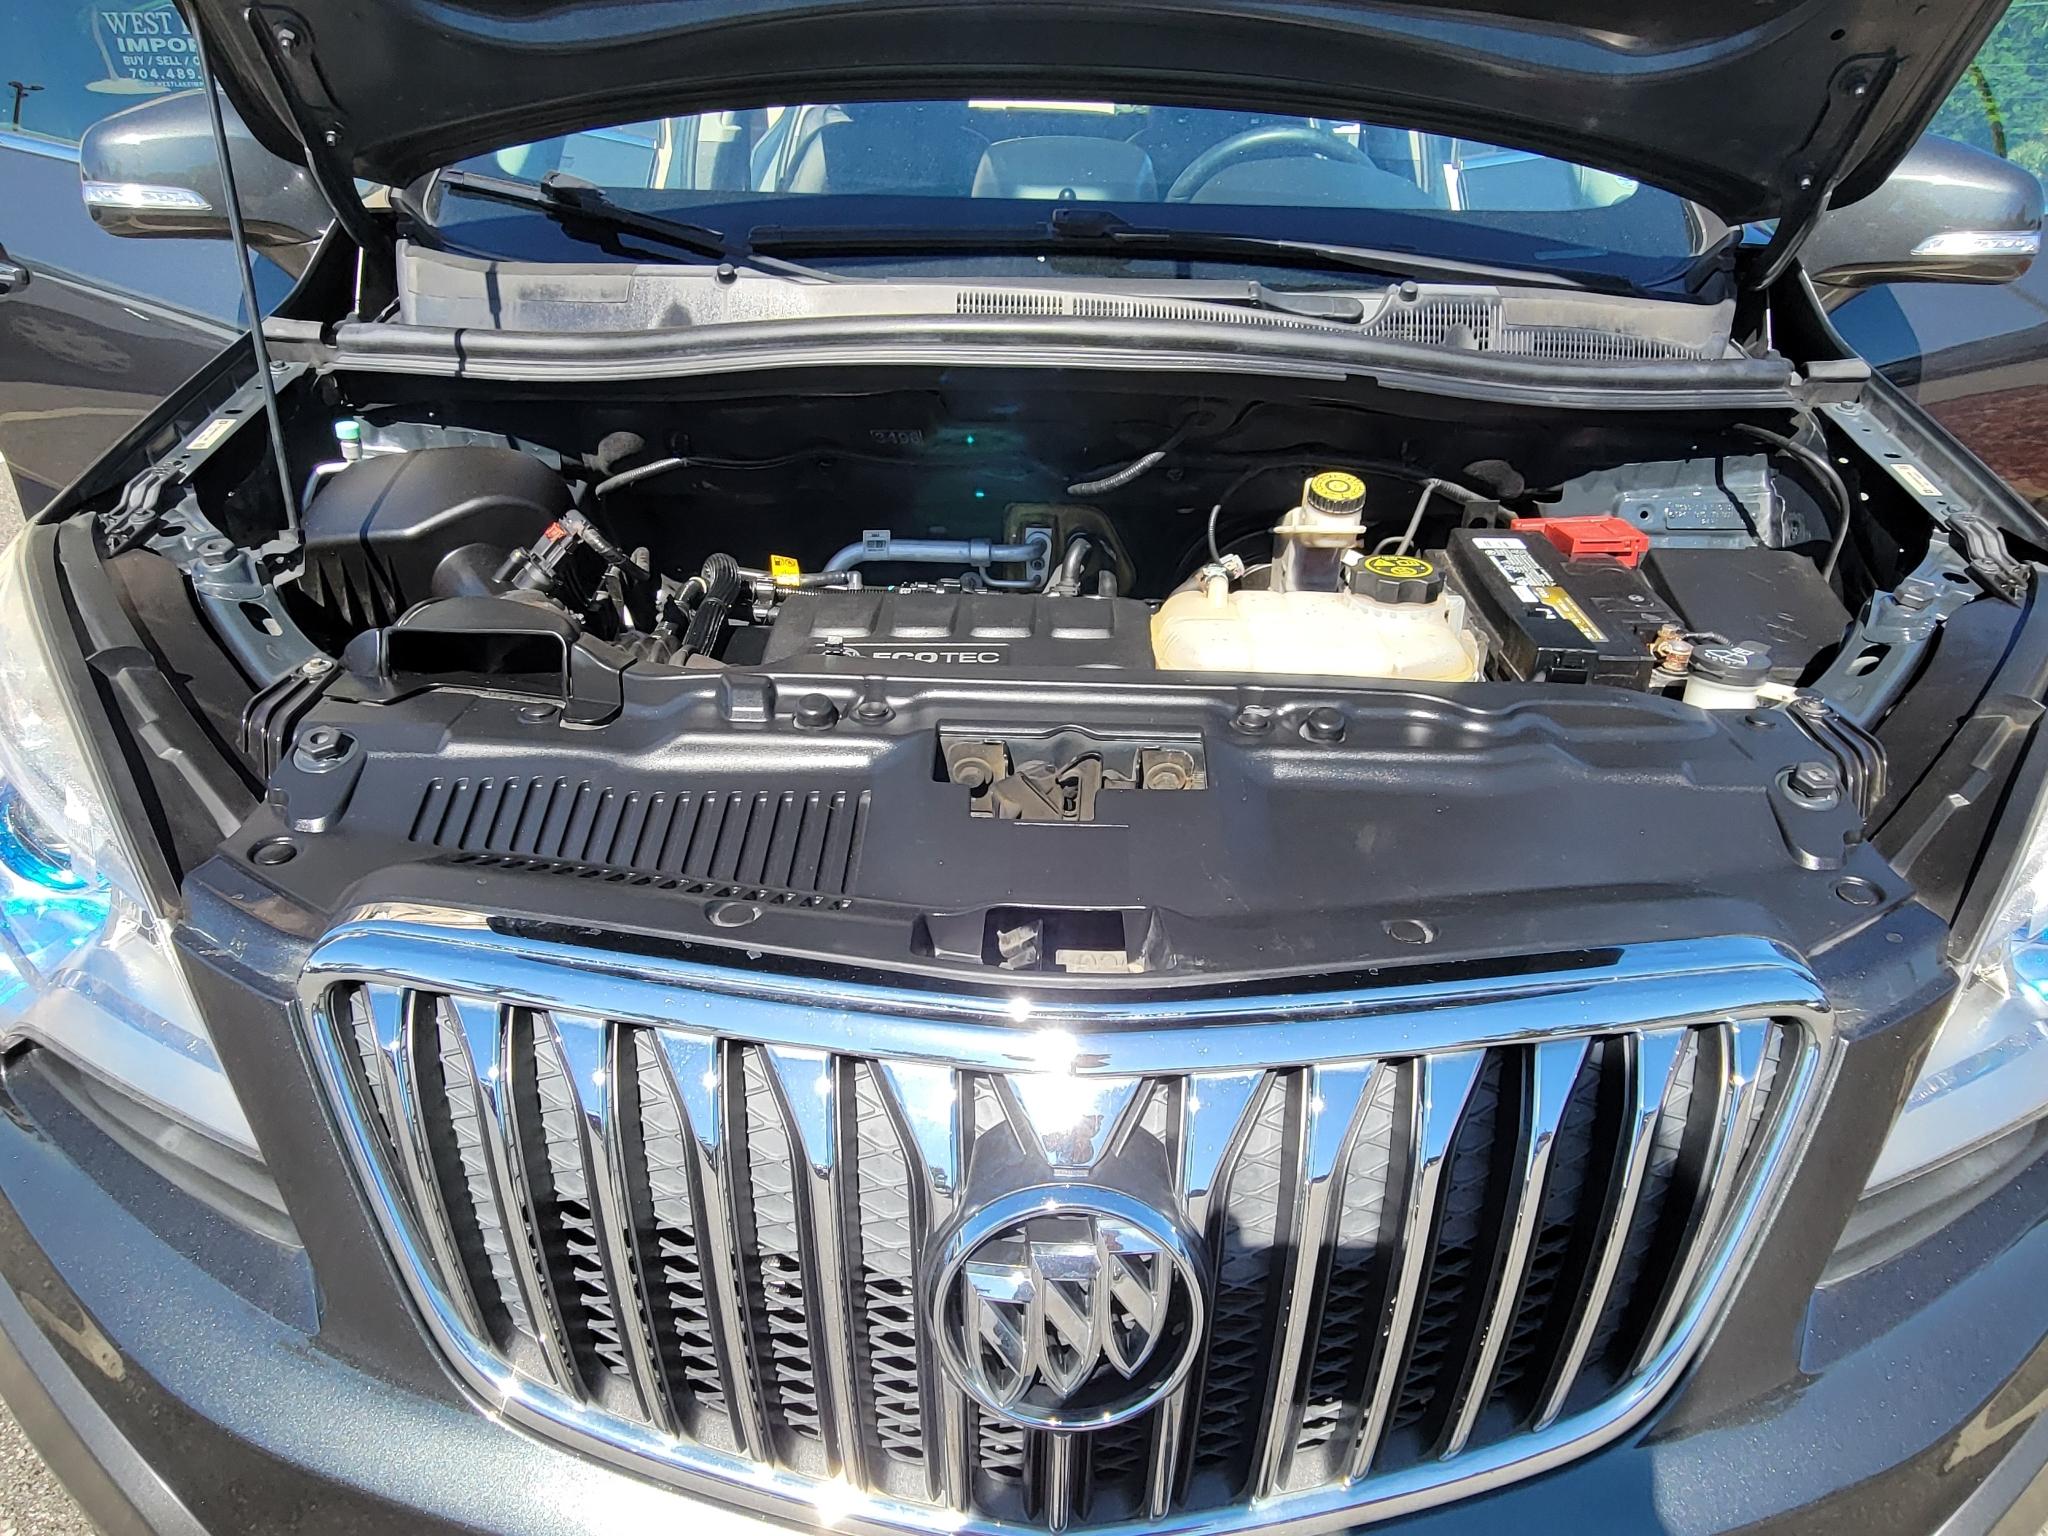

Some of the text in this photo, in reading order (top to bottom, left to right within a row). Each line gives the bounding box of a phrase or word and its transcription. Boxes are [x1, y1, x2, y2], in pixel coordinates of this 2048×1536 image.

[102, 12, 171, 34] WEST
[123, 56, 143, 66] BUY
[156, 56, 182, 66] SELL
[872, 651, 1000, 663] ECOTEC
